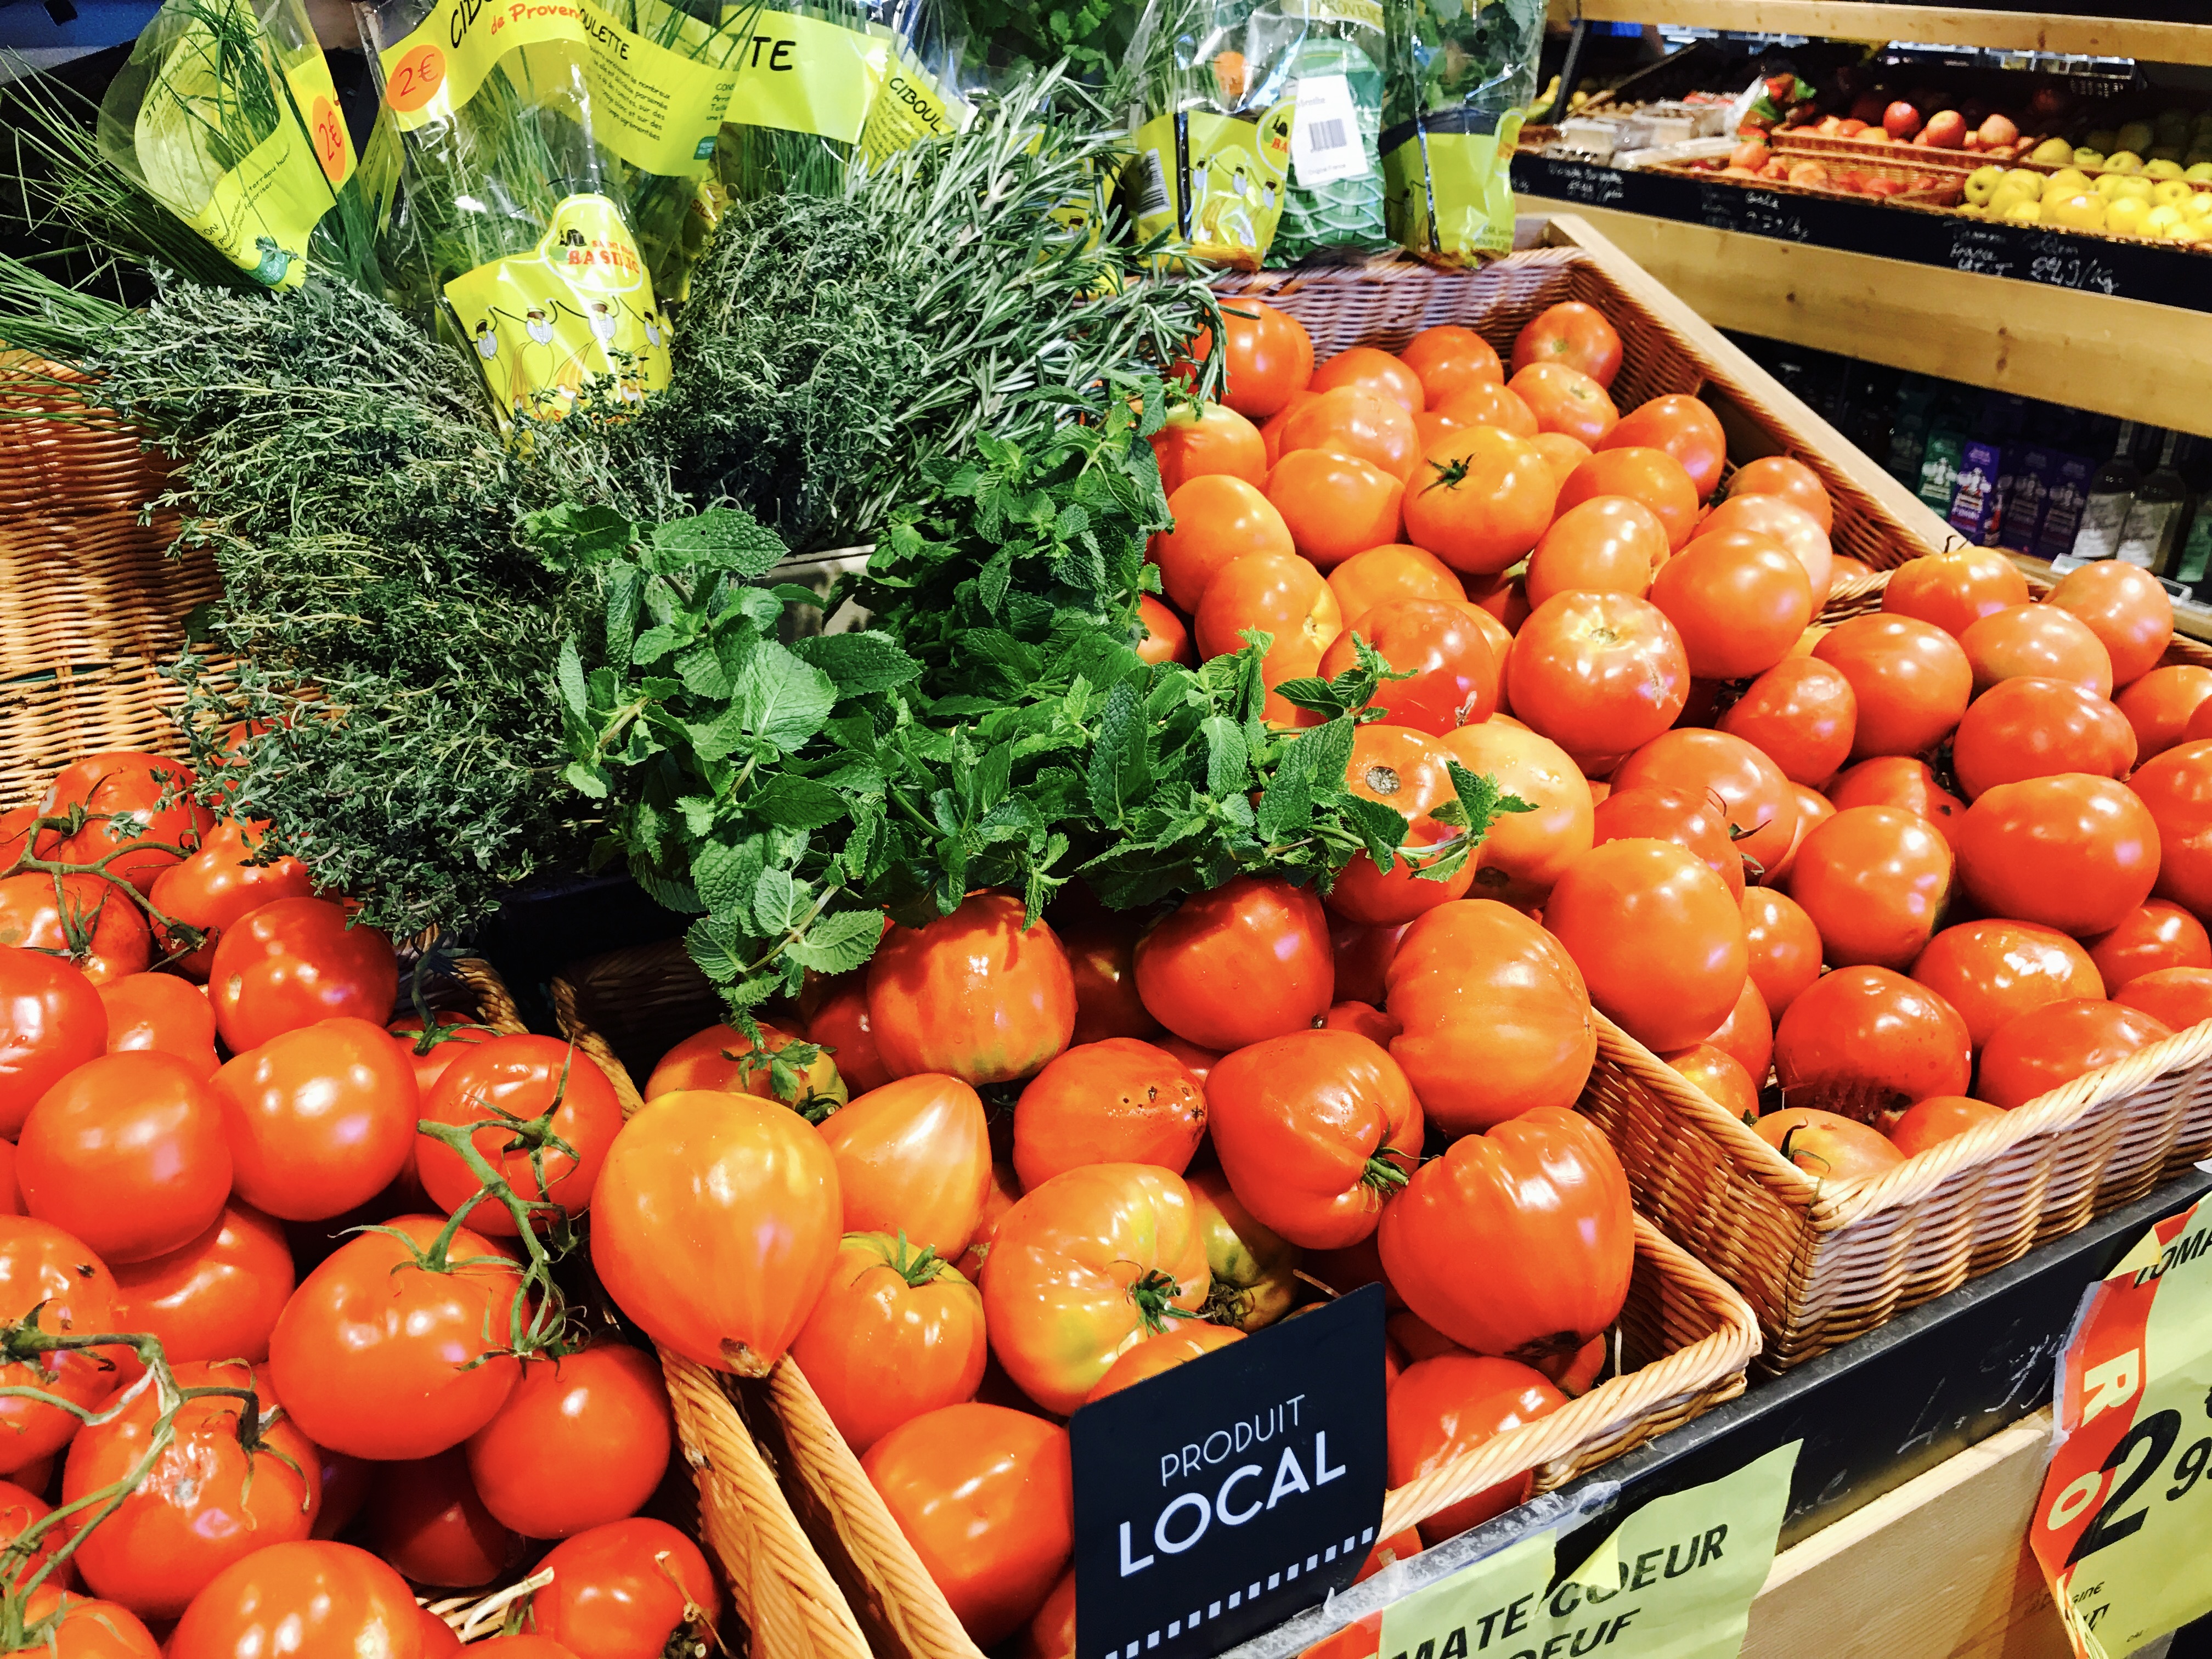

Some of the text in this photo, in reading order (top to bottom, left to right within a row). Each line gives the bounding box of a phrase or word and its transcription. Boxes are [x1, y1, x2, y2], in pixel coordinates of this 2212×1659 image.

[491, 15, 505, 35] de
[751, 36, 797, 72] TE
[889, 77, 941, 133] CIBOUL
[244, 180, 274, 211] favoriser
[248, 166, 276, 192] terreau
[1161, 1394, 1305, 1487] PRODUIT
[1120, 1430, 1346, 1577] LOCAL
